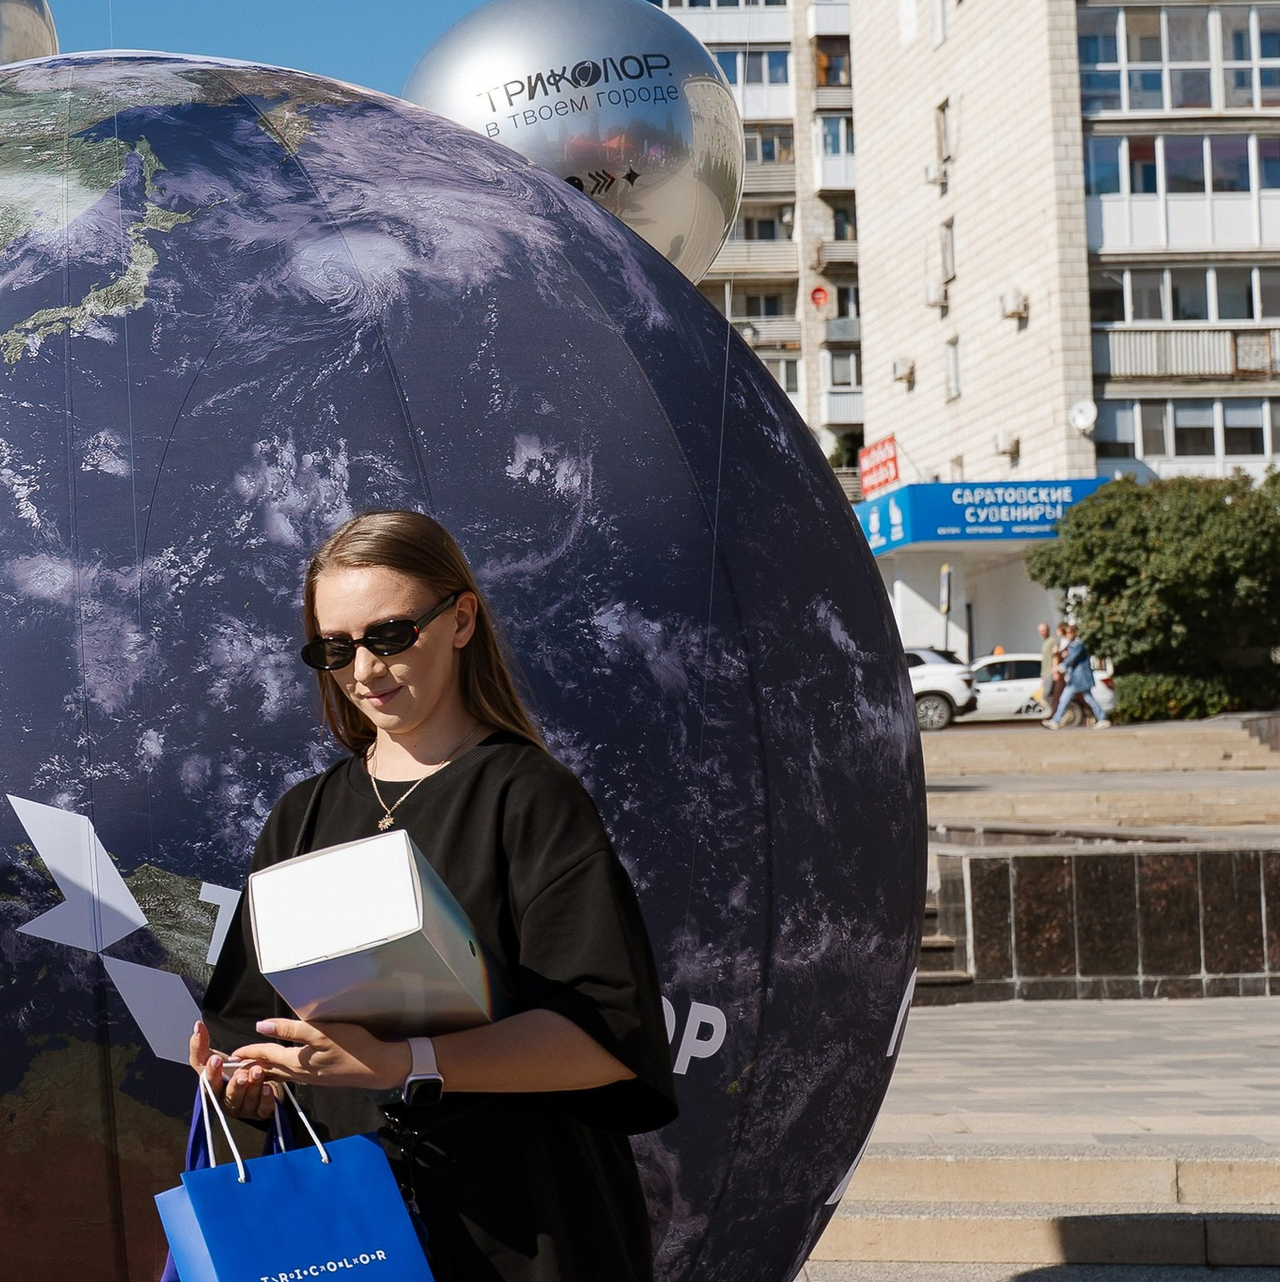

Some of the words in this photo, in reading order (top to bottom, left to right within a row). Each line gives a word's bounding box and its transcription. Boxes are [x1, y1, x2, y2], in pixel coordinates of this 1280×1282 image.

[507, 95, 589, 129] твоем
[596, 84, 680, 109] городе
[951, 486, 1073, 505] САРАТОВСКИЕ
[964, 504, 1063, 523] СУВЕНИРЫ
